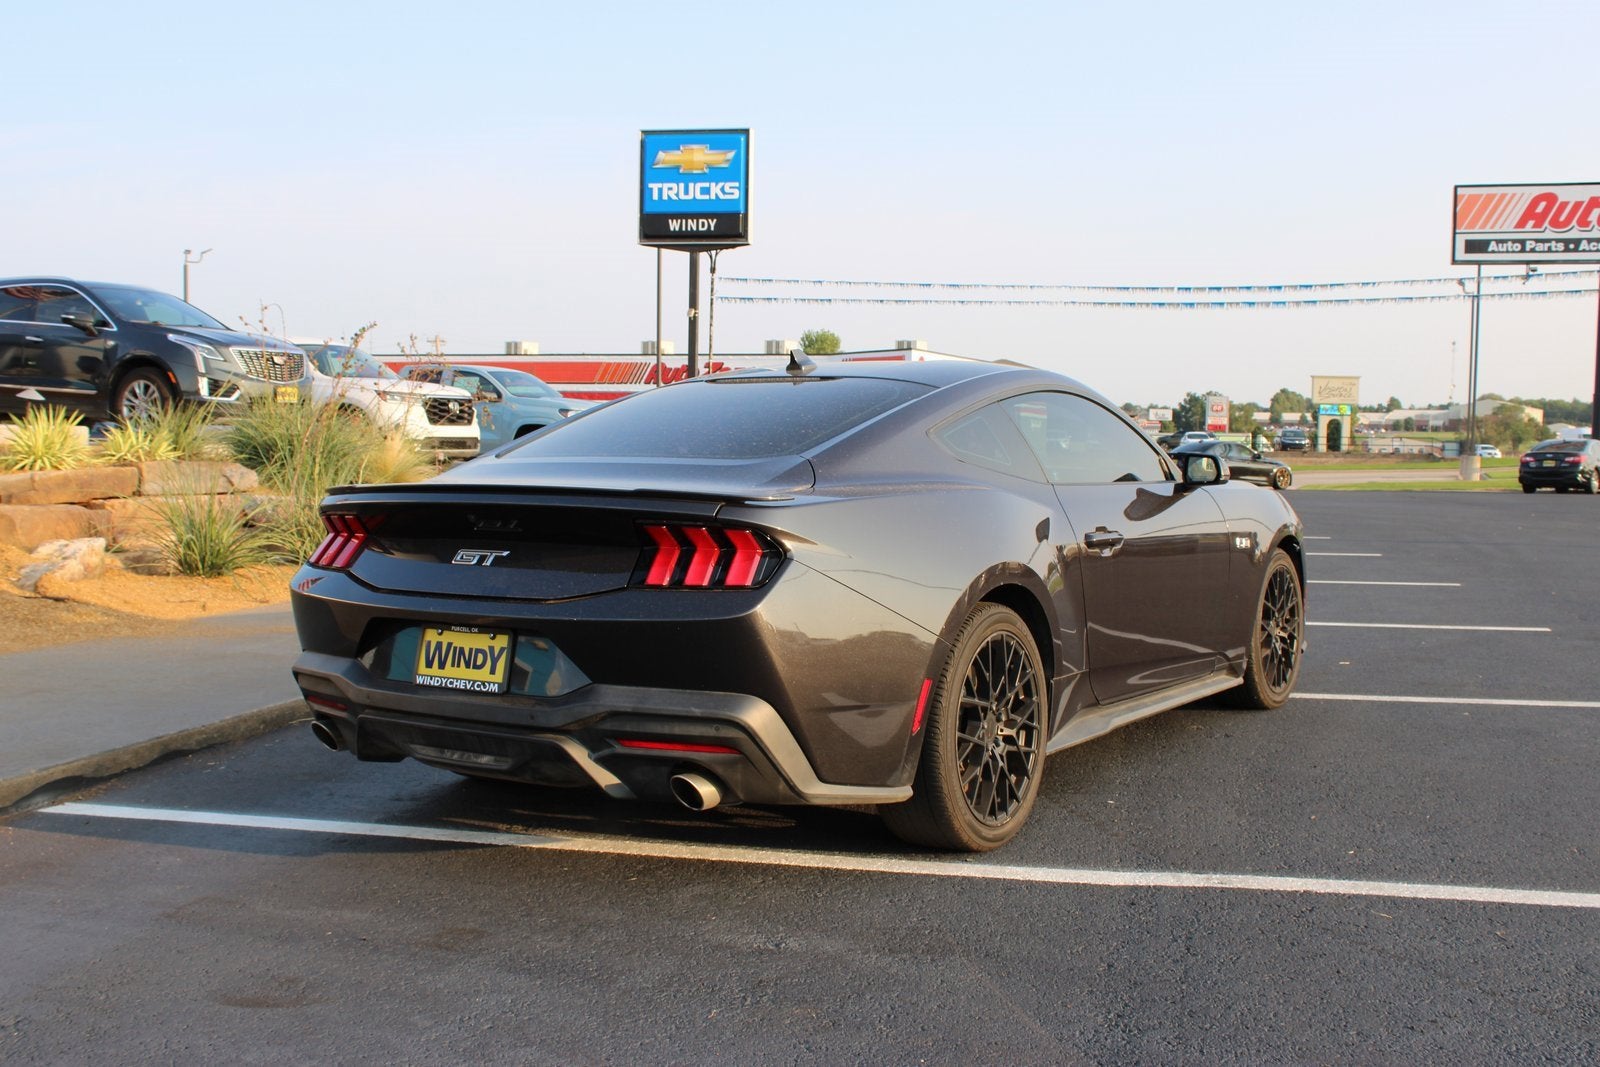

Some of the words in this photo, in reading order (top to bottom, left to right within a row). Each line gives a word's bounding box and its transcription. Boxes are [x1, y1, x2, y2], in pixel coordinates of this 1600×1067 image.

[648, 182, 740, 201] TRUCKS
[1513, 192, 1600, 230] Aut
[668, 218, 717, 232] WINDY
[1488, 241, 1522, 252] Auto
[1525, 240, 1565, 251] Parts
[451, 548, 511, 567] GT
[415, 674, 498, 693] WINDYCHEV.COM
